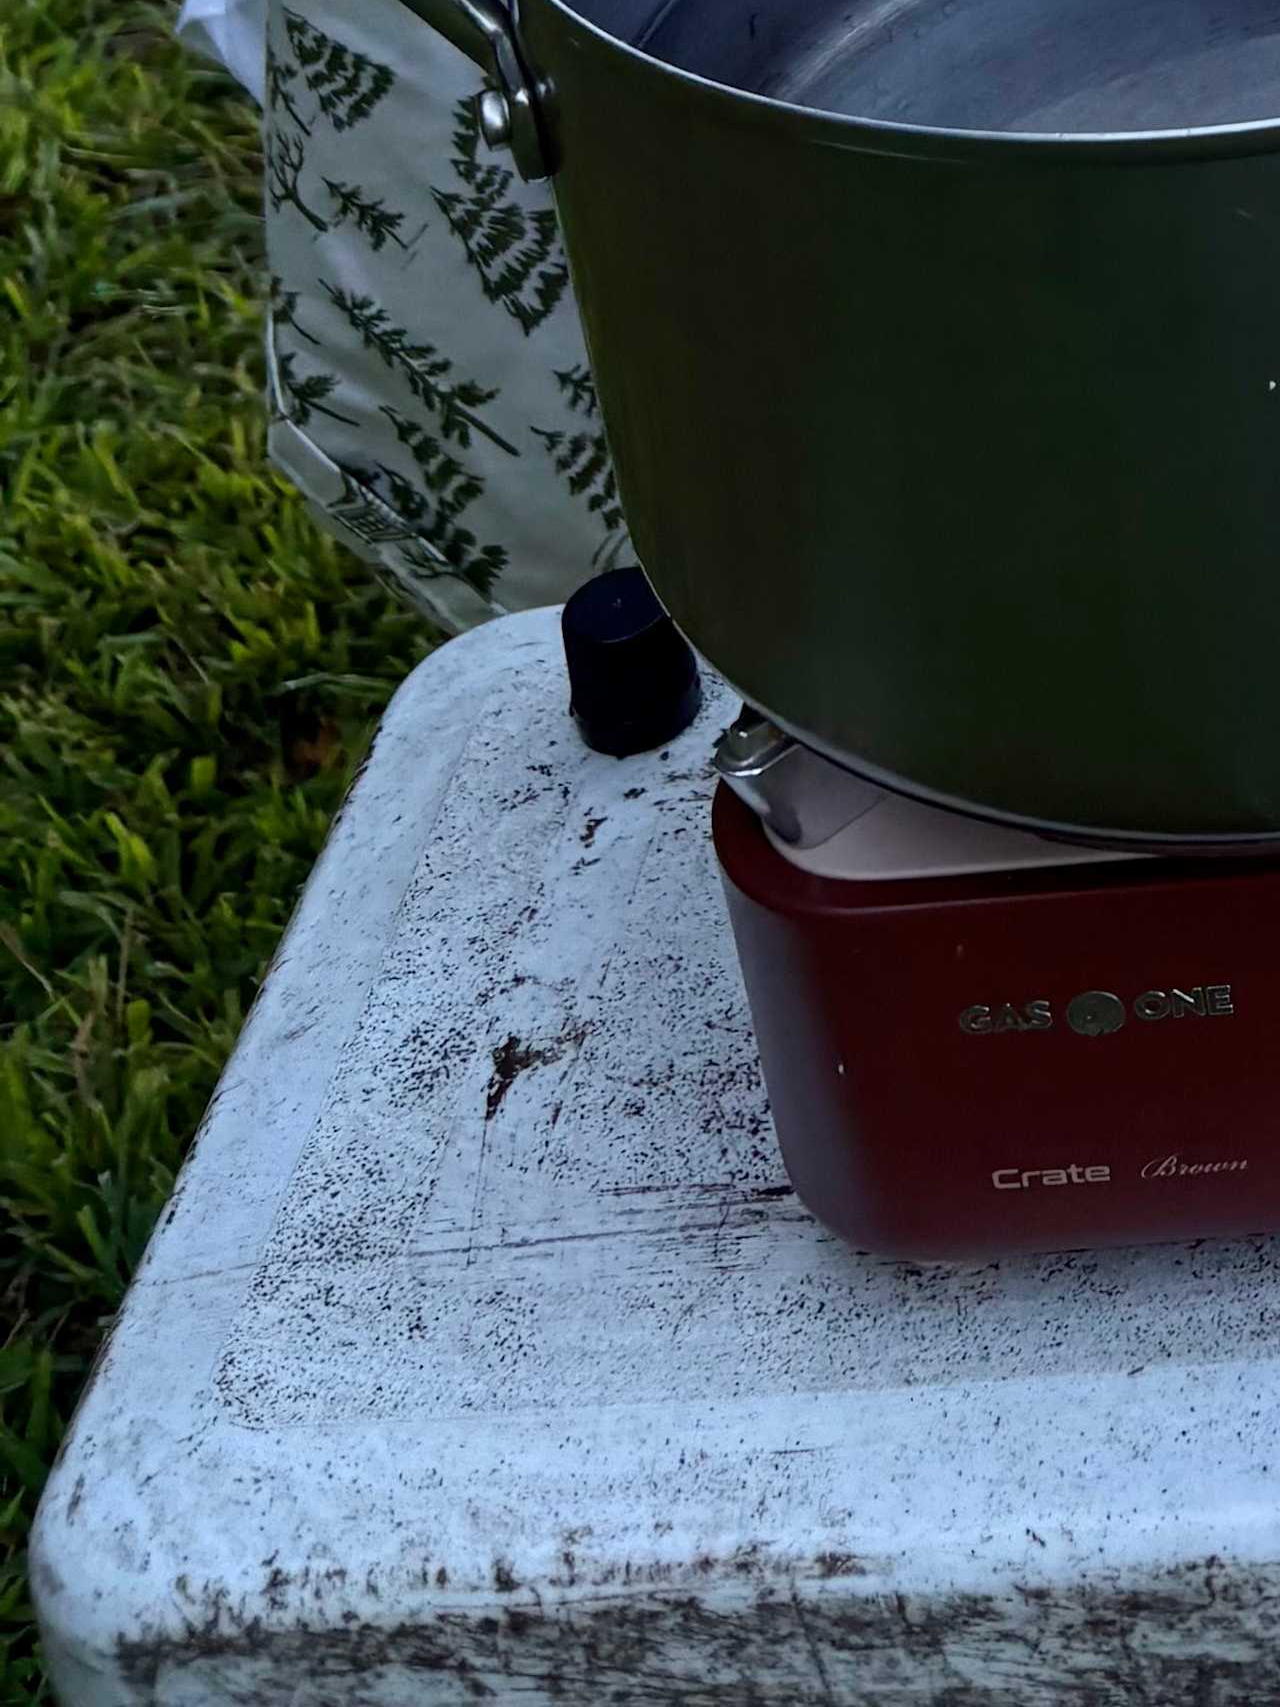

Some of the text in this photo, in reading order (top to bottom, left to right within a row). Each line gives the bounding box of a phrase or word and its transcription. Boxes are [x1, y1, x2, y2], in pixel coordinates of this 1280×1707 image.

[959, 985, 1235, 1034] GAS ONE
[991, 1152, 1249, 1190] Crate Brown
